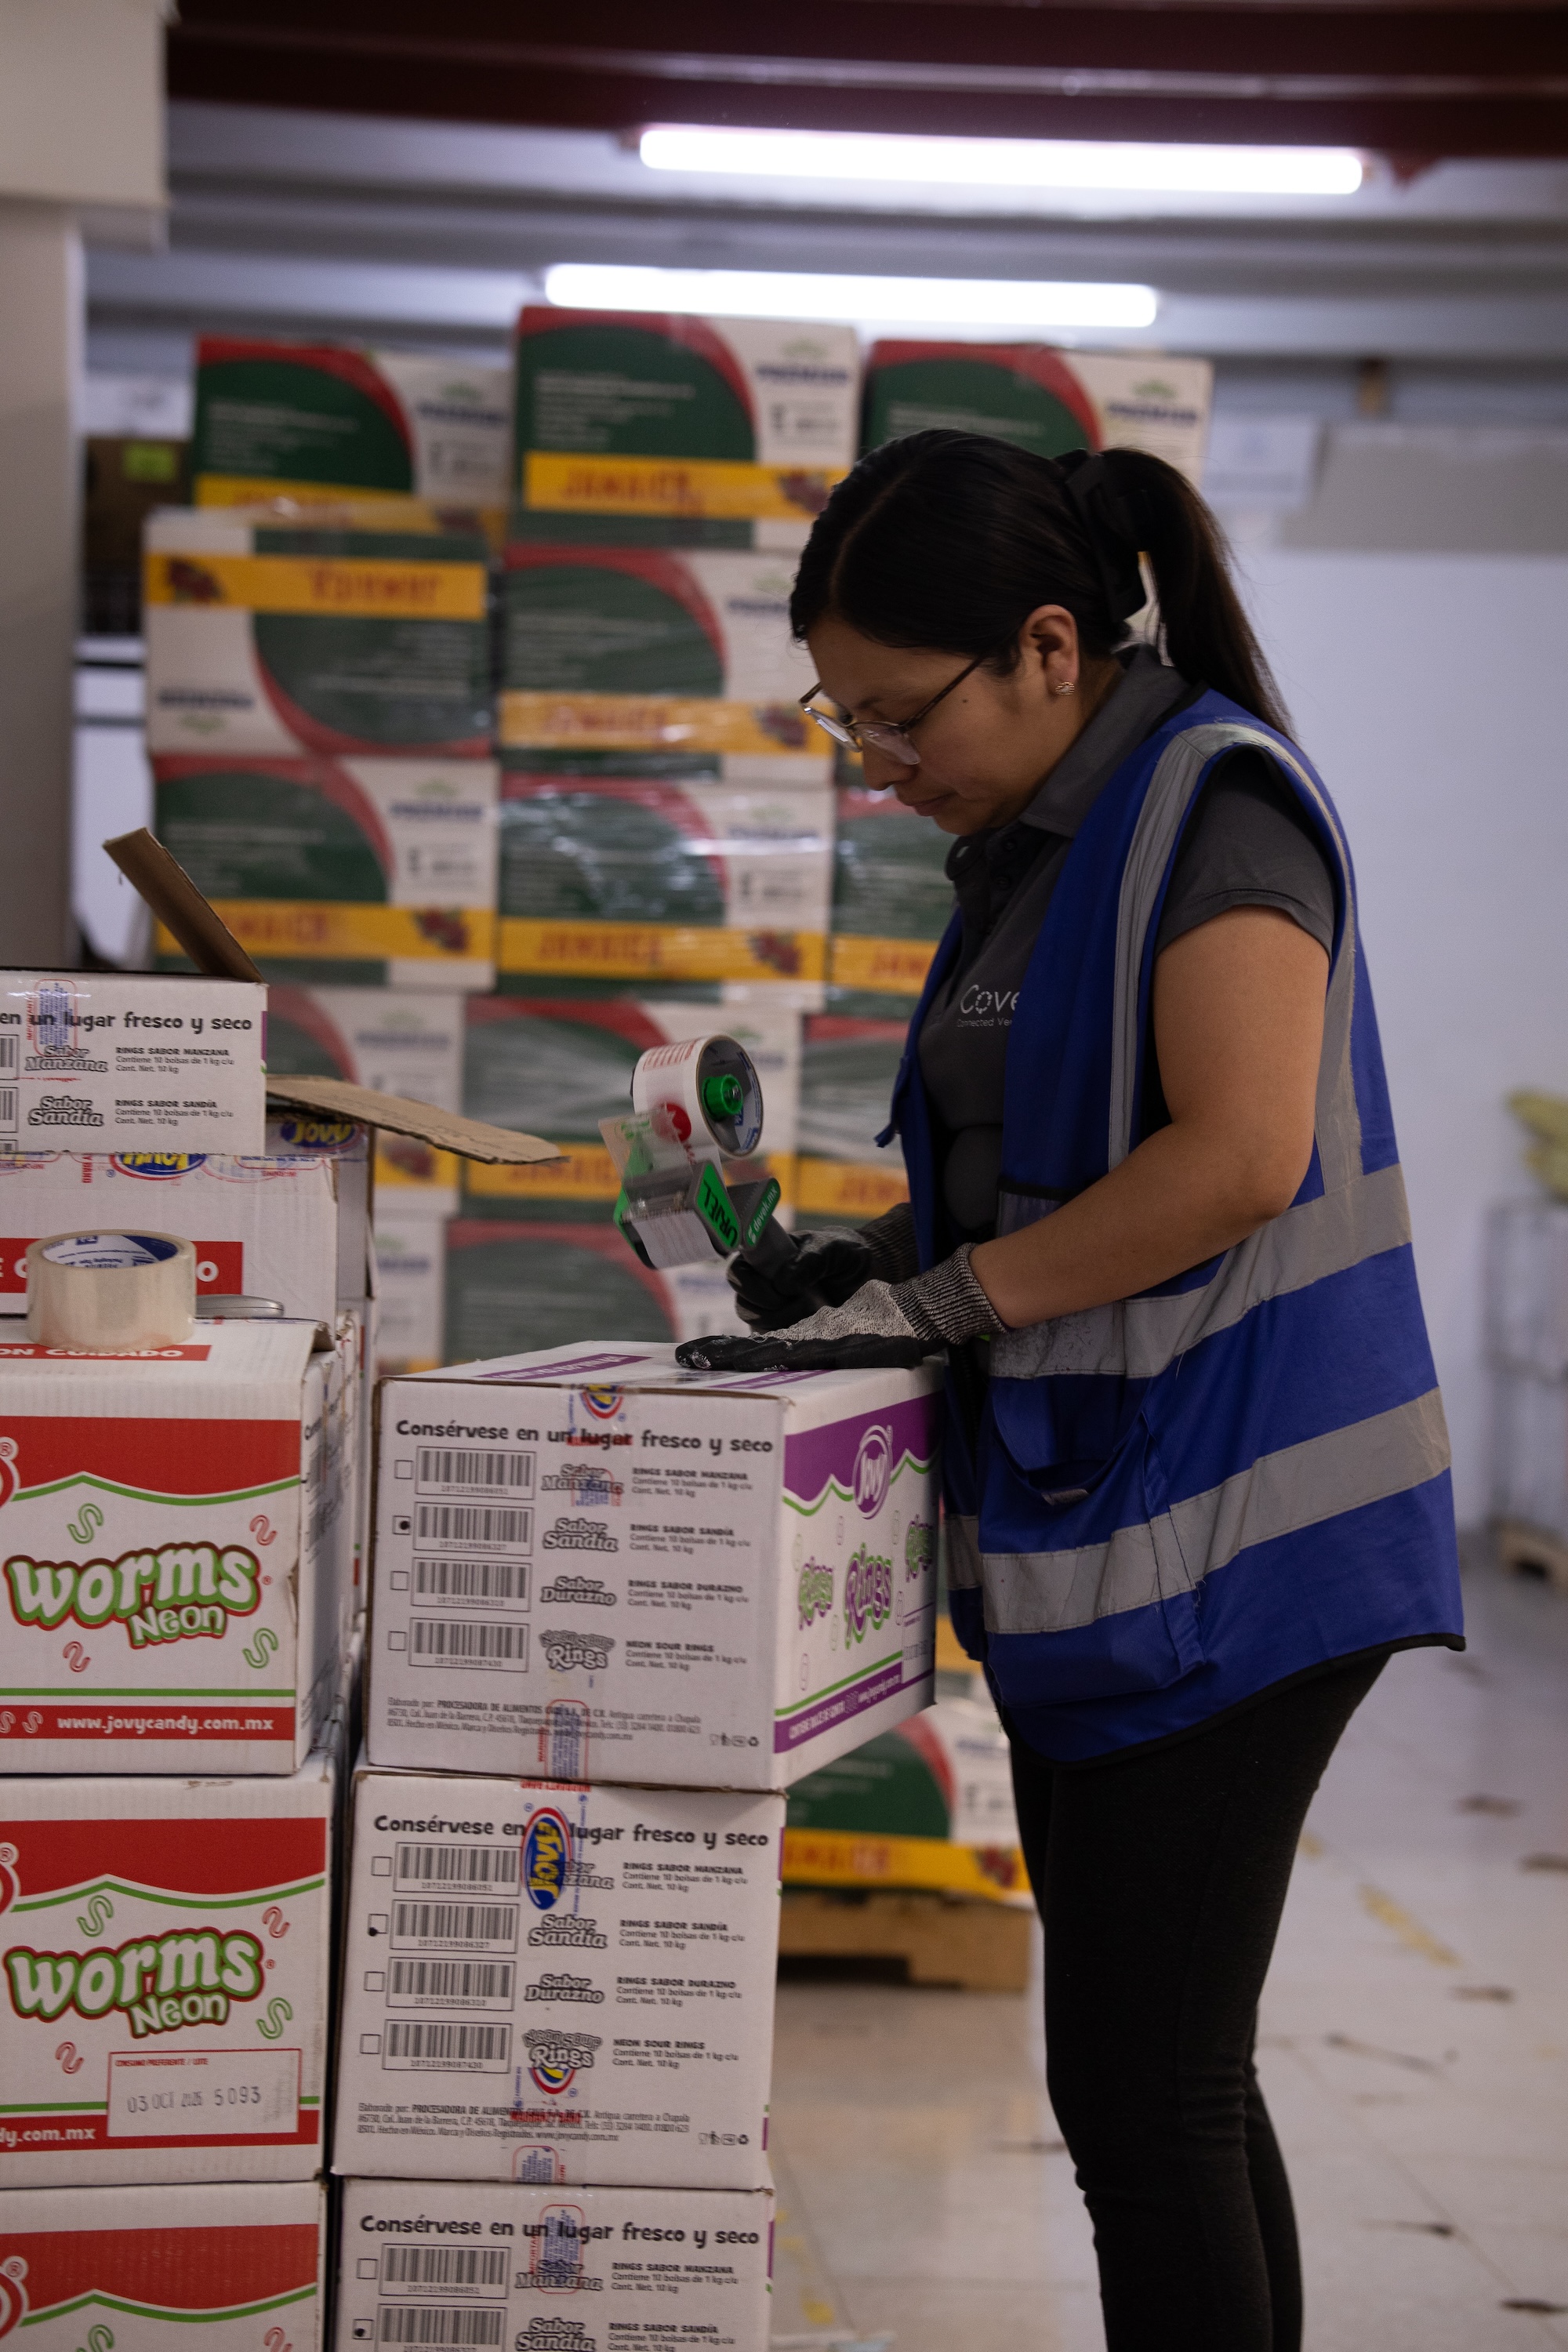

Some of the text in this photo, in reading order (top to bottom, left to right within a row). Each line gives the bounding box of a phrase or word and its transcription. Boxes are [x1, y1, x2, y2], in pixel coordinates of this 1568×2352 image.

[31, 1013, 55, 1026] un
[64, 1011, 116, 1032] lugar
[124, 1011, 183, 1029] fresco
[191, 1017, 204, 1035] y
[210, 1017, 252, 1031] seco
[43, 1044, 89, 1058] Sabor
[24, 1055, 109, 1073] Manzana
[40, 1095, 93, 1110] Sabor
[27, 1106, 105, 1127] Sandía
[395, 1420, 509, 1439] Consérvese
[517, 1428, 539, 1441] en
[546, 1429, 573, 1443] un
[581, 1428, 633, 1450] lugar
[641, 1430, 702, 1449] fresco
[709, 1438, 723, 1456] y
[730, 1438, 773, 1452] seco
[555, 1517, 608, 1533] Sabor
[542, 1530, 619, 1552] Sandía
[5, 1543, 260, 1626] worms
[130, 1604, 226, 1646] Neon
[545, 1644, 608, 1670] Rings
[56, 1715, 274, 1734] www.jovycandy.com.mx
[374, 1814, 495, 1834] Consérvese
[502, 1823, 525, 1835] en
[633, 1824, 695, 1843] fresco
[703, 1831, 717, 1850] y
[725, 1832, 768, 1846] seco
[622, 1862, 743, 1875] RINGS SABOR MANZANA
[541, 1914, 597, 1929] Sabor
[620, 1919, 650, 1928] RINGS
[654, 1921, 688, 1929] SABOR
[528, 1927, 608, 1949] Sandía
[6, 1930, 261, 2019] worms
[539, 1973, 592, 1989] Sabor
[616, 1976, 736, 1988] RINGS SABOR DURAZNO
[524, 1984, 605, 2004] Durazno
[129, 1993, 228, 2037] Neon
[613, 2038, 706, 2049] NEON SOUR RINGS
[528, 2043, 594, 2070] Rings
[127, 2095, 149, 2113] 03
[360, 2214, 481, 2234] Consérvese
[490, 2222, 514, 2235] en
[522, 2223, 549, 2237] un
[558, 2221, 614, 2244] lugar
[622, 2222, 686, 2241] fresco
[693, 2230, 707, 2249] y
[714, 2230, 759, 2244] seco
[612, 2262, 735, 2274] RINGS SABOR MANZANA
[528, 2317, 586, 2334] Sabor
[643, 2324, 677, 2332] SABOR
[514, 2332, 597, 2352] Sandía
